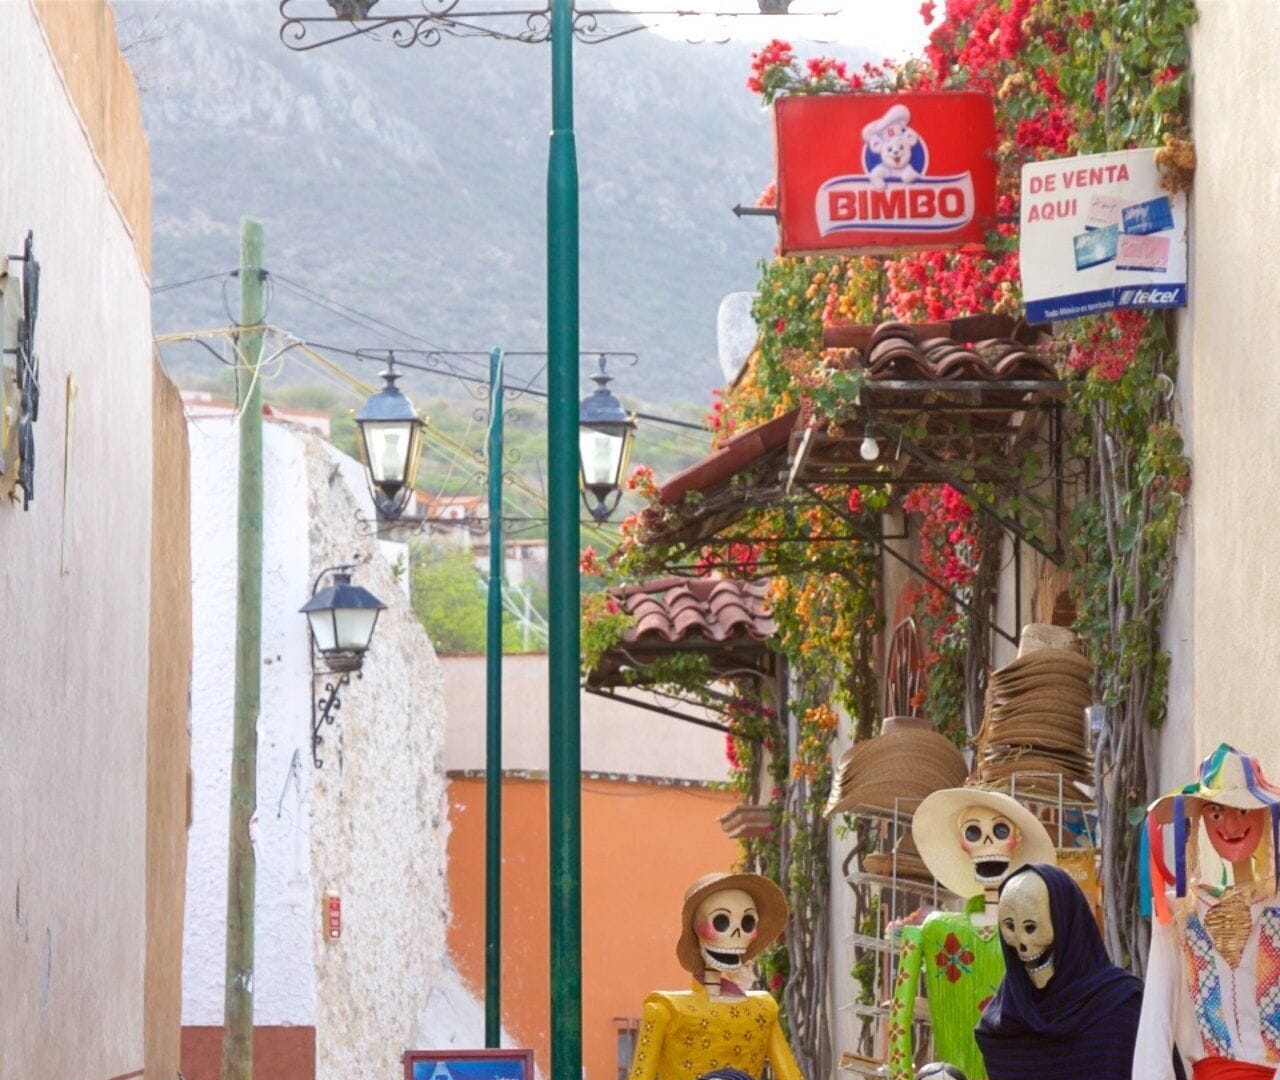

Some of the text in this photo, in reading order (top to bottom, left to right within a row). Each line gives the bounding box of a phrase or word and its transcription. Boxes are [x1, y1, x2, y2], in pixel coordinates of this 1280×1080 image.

[1030, 164, 1129, 194] DE VENTA
[828, 187, 965, 221] BIMBO
[1027, 198, 1078, 223] AQUI
[1132, 288, 1180, 305] telcel
